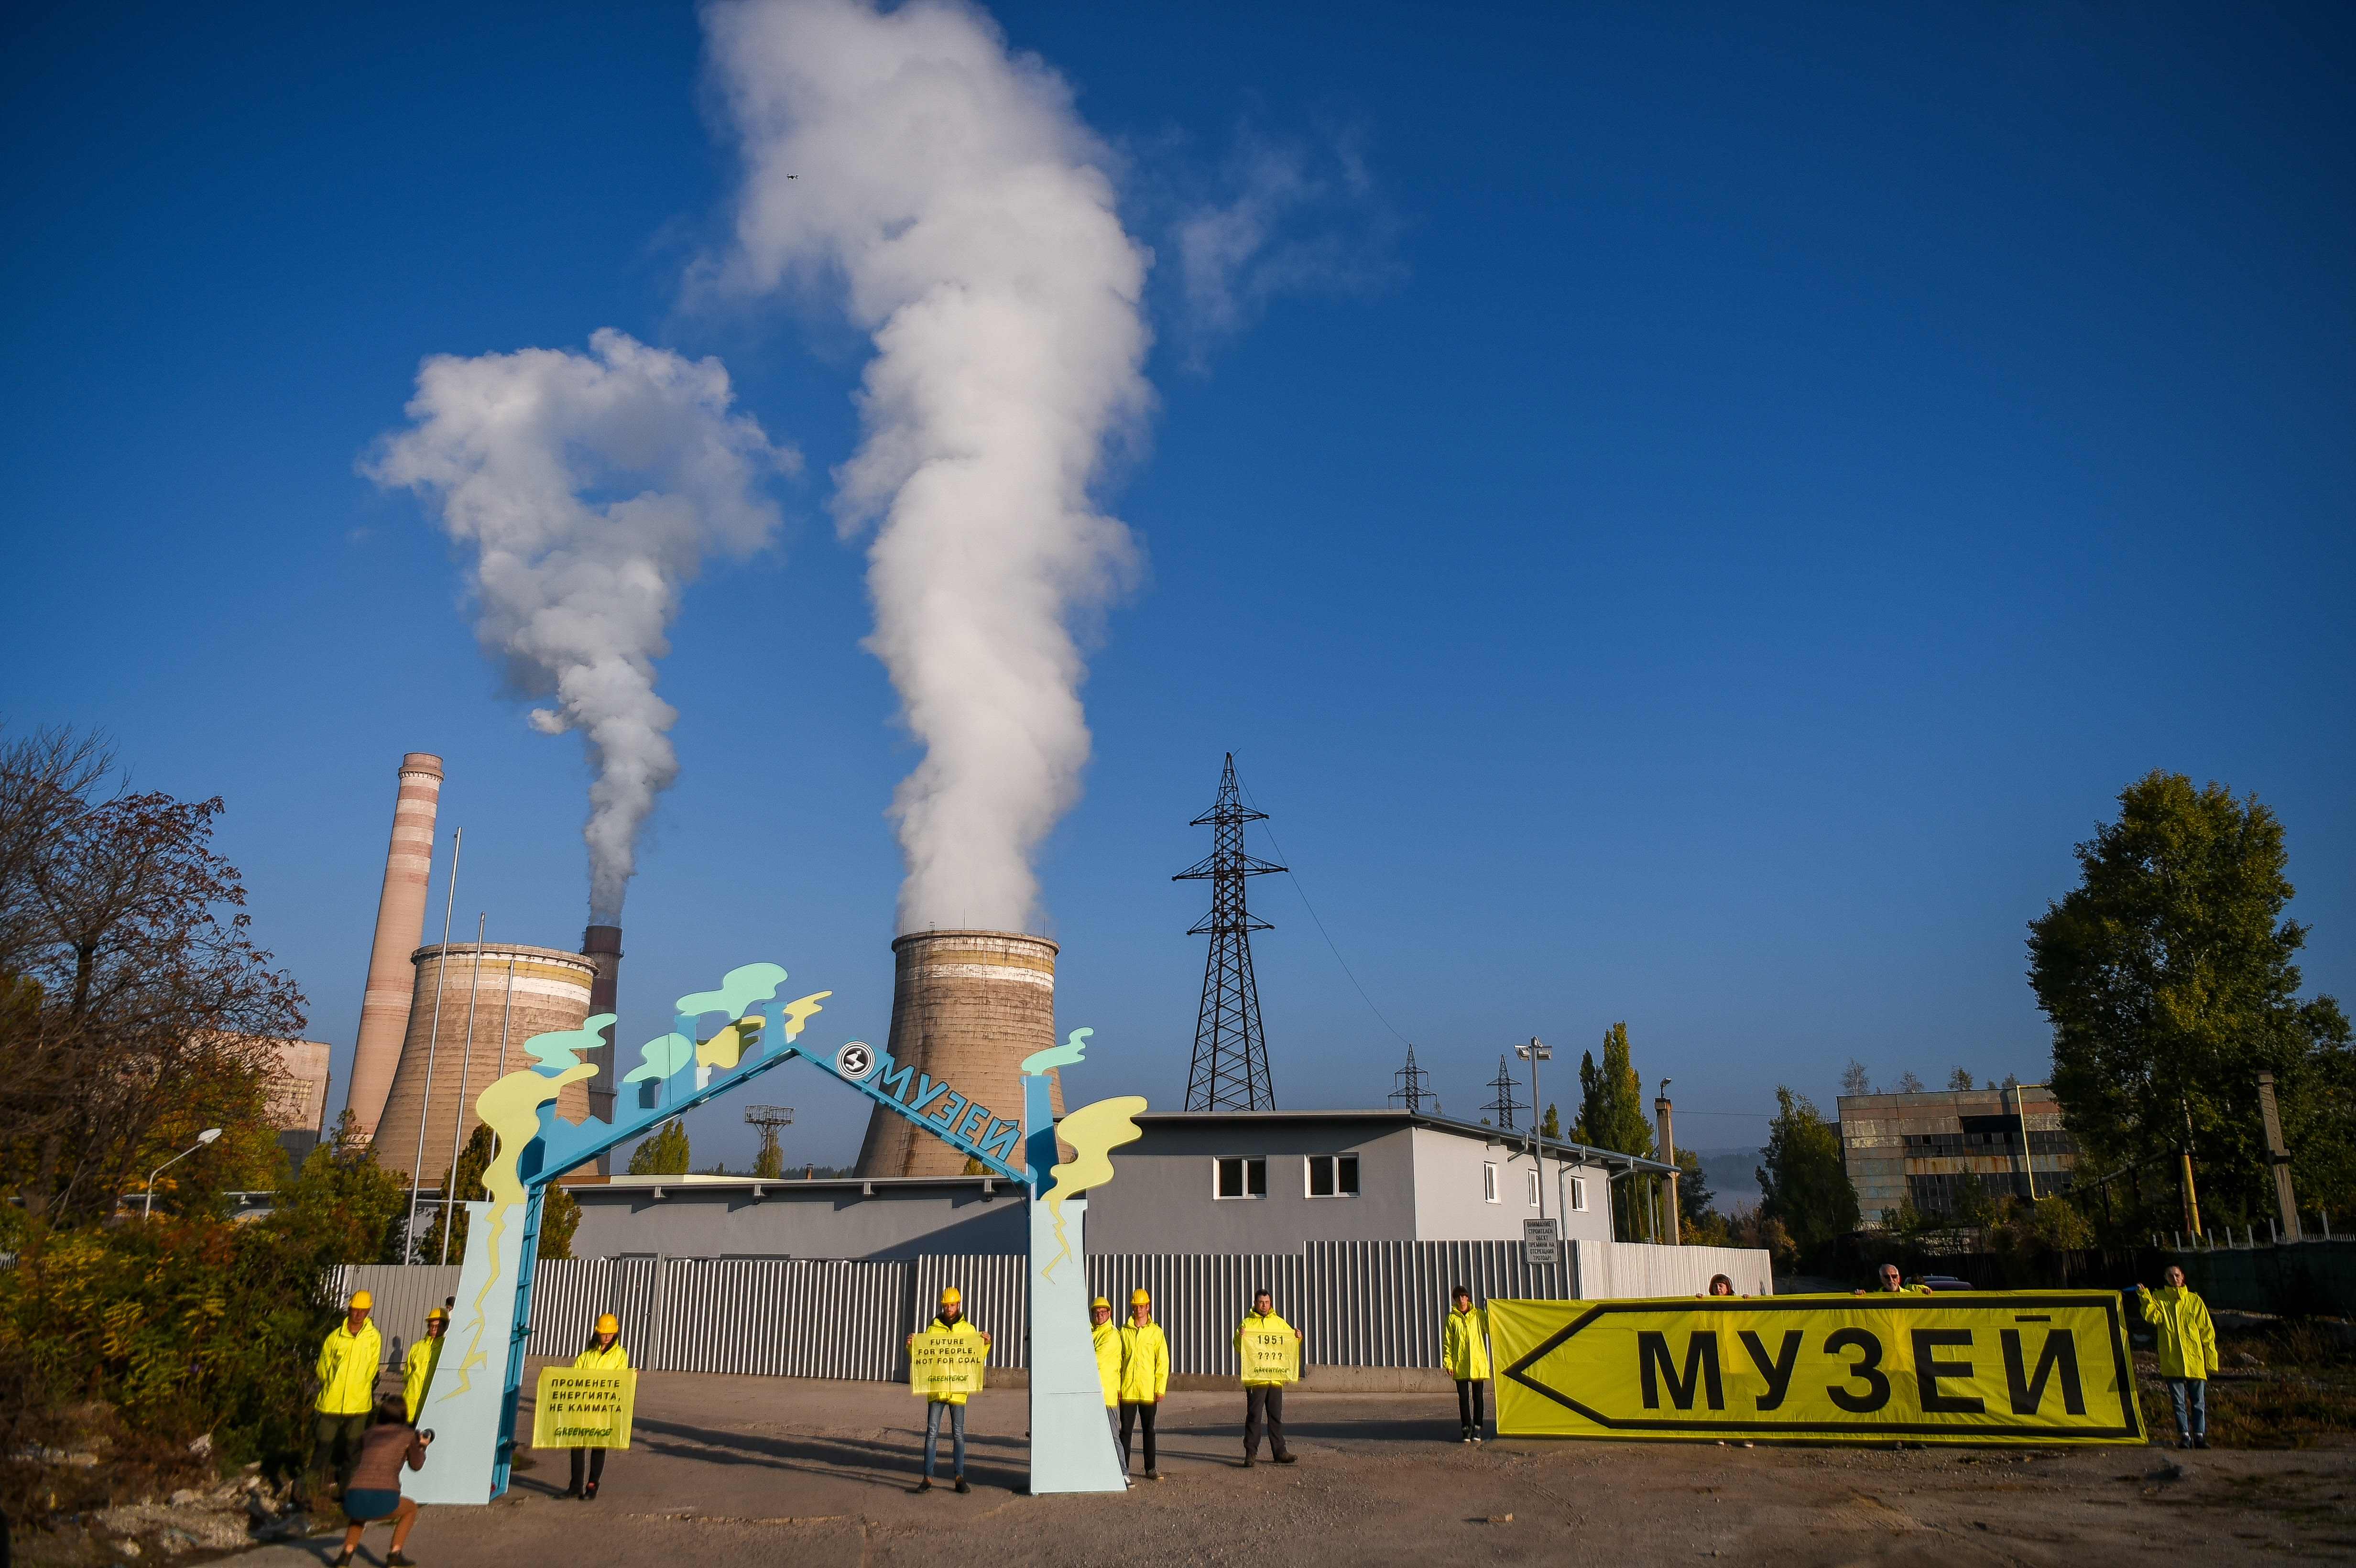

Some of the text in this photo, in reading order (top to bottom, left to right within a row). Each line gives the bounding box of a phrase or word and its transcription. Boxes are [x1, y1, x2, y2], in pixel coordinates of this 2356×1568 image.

[862, 1054, 1022, 1161] МУЗЕЙ
[1257, 1334, 1283, 1345] 1951
[1258, 1352, 1282, 1360] ????
[1636, 1315, 2086, 1415] МУЗЕЙ
[551, 1379, 620, 1387] ПРОМЕНЕТЕ
[552, 1391, 621, 1402] ЕНЕРГИЯТА,
[550, 1404, 622, 1412] НЕ КЛИМАТА
